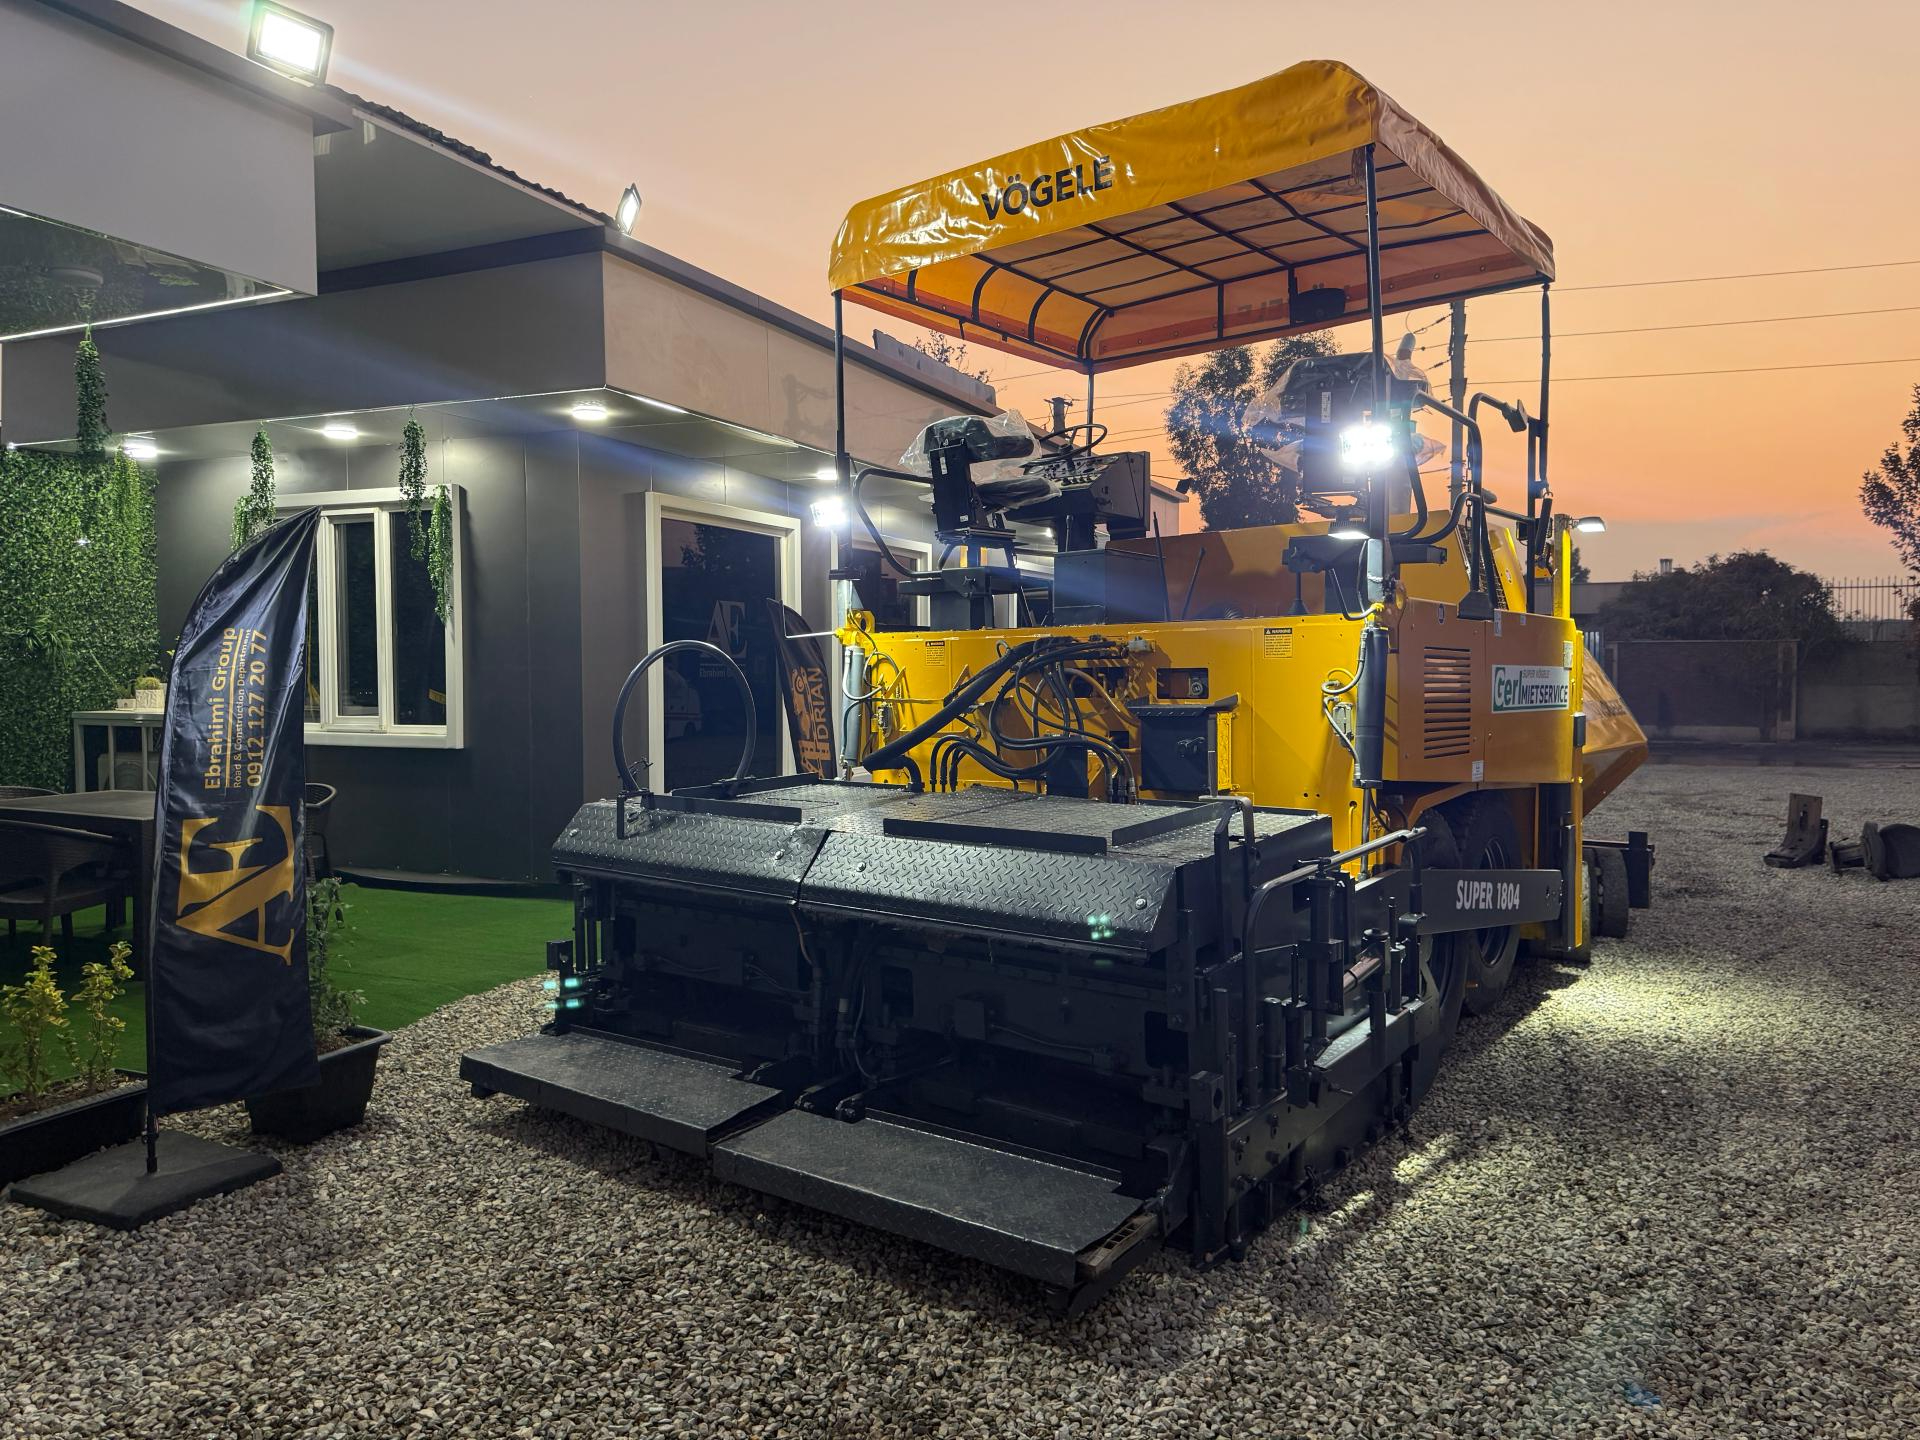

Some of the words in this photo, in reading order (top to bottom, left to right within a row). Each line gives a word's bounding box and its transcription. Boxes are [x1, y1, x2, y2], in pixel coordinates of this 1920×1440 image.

[981, 155, 1113, 221] VÖGELE
[212, 627, 238, 691] Group
[237, 629, 251, 687] Department
[251, 629, 267, 655] 77
[249, 660, 266, 686] 20
[248, 691, 265, 729] 127
[1521, 684, 1568, 705] MIETSERVICE
[234, 688, 245, 751] Construction
[205, 697, 225, 790] Ebrahimi
[233, 754, 242, 764] &
[247, 736, 264, 787] 0912
[233, 764, 242, 788] Road
[1456, 879, 1493, 910] SUPER
[1496, 882, 1520, 910] 1804
